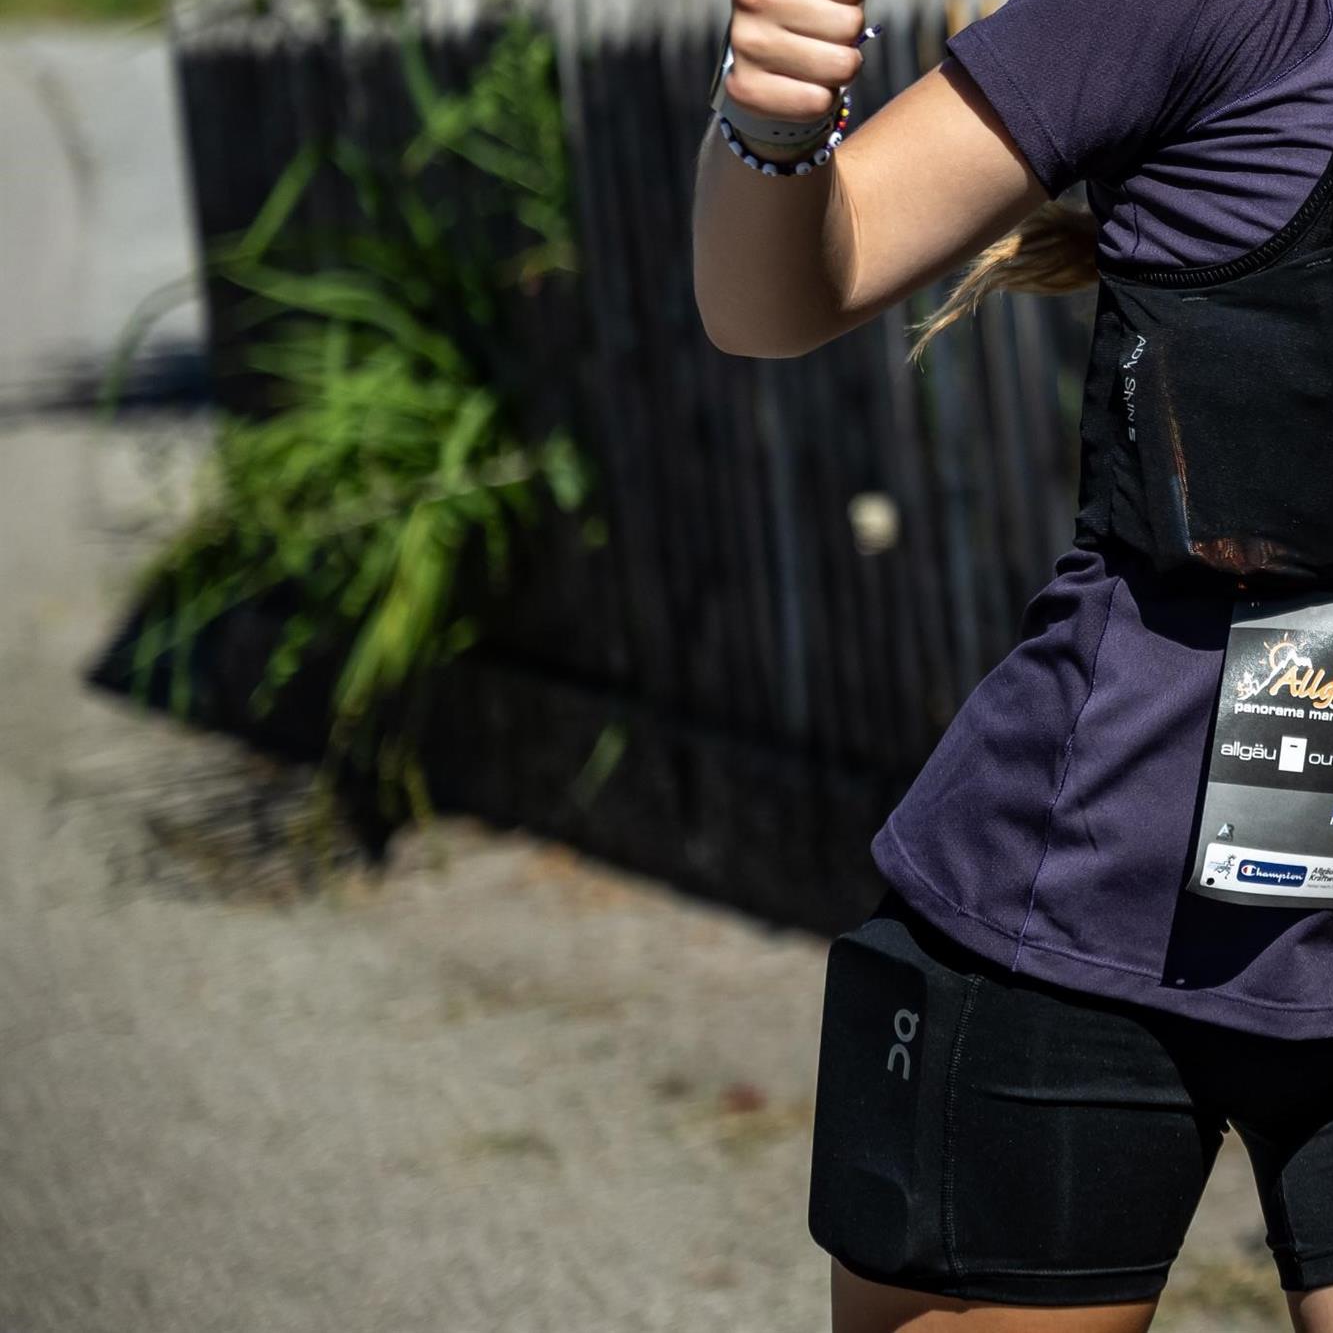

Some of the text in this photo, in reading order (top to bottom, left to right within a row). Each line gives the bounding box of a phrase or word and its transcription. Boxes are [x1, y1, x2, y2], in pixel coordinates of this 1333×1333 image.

[1234, 702, 1305, 719] panorama
[1220, 741, 1277, 761] allgäu
[1241, 864, 1304, 883] Champion
